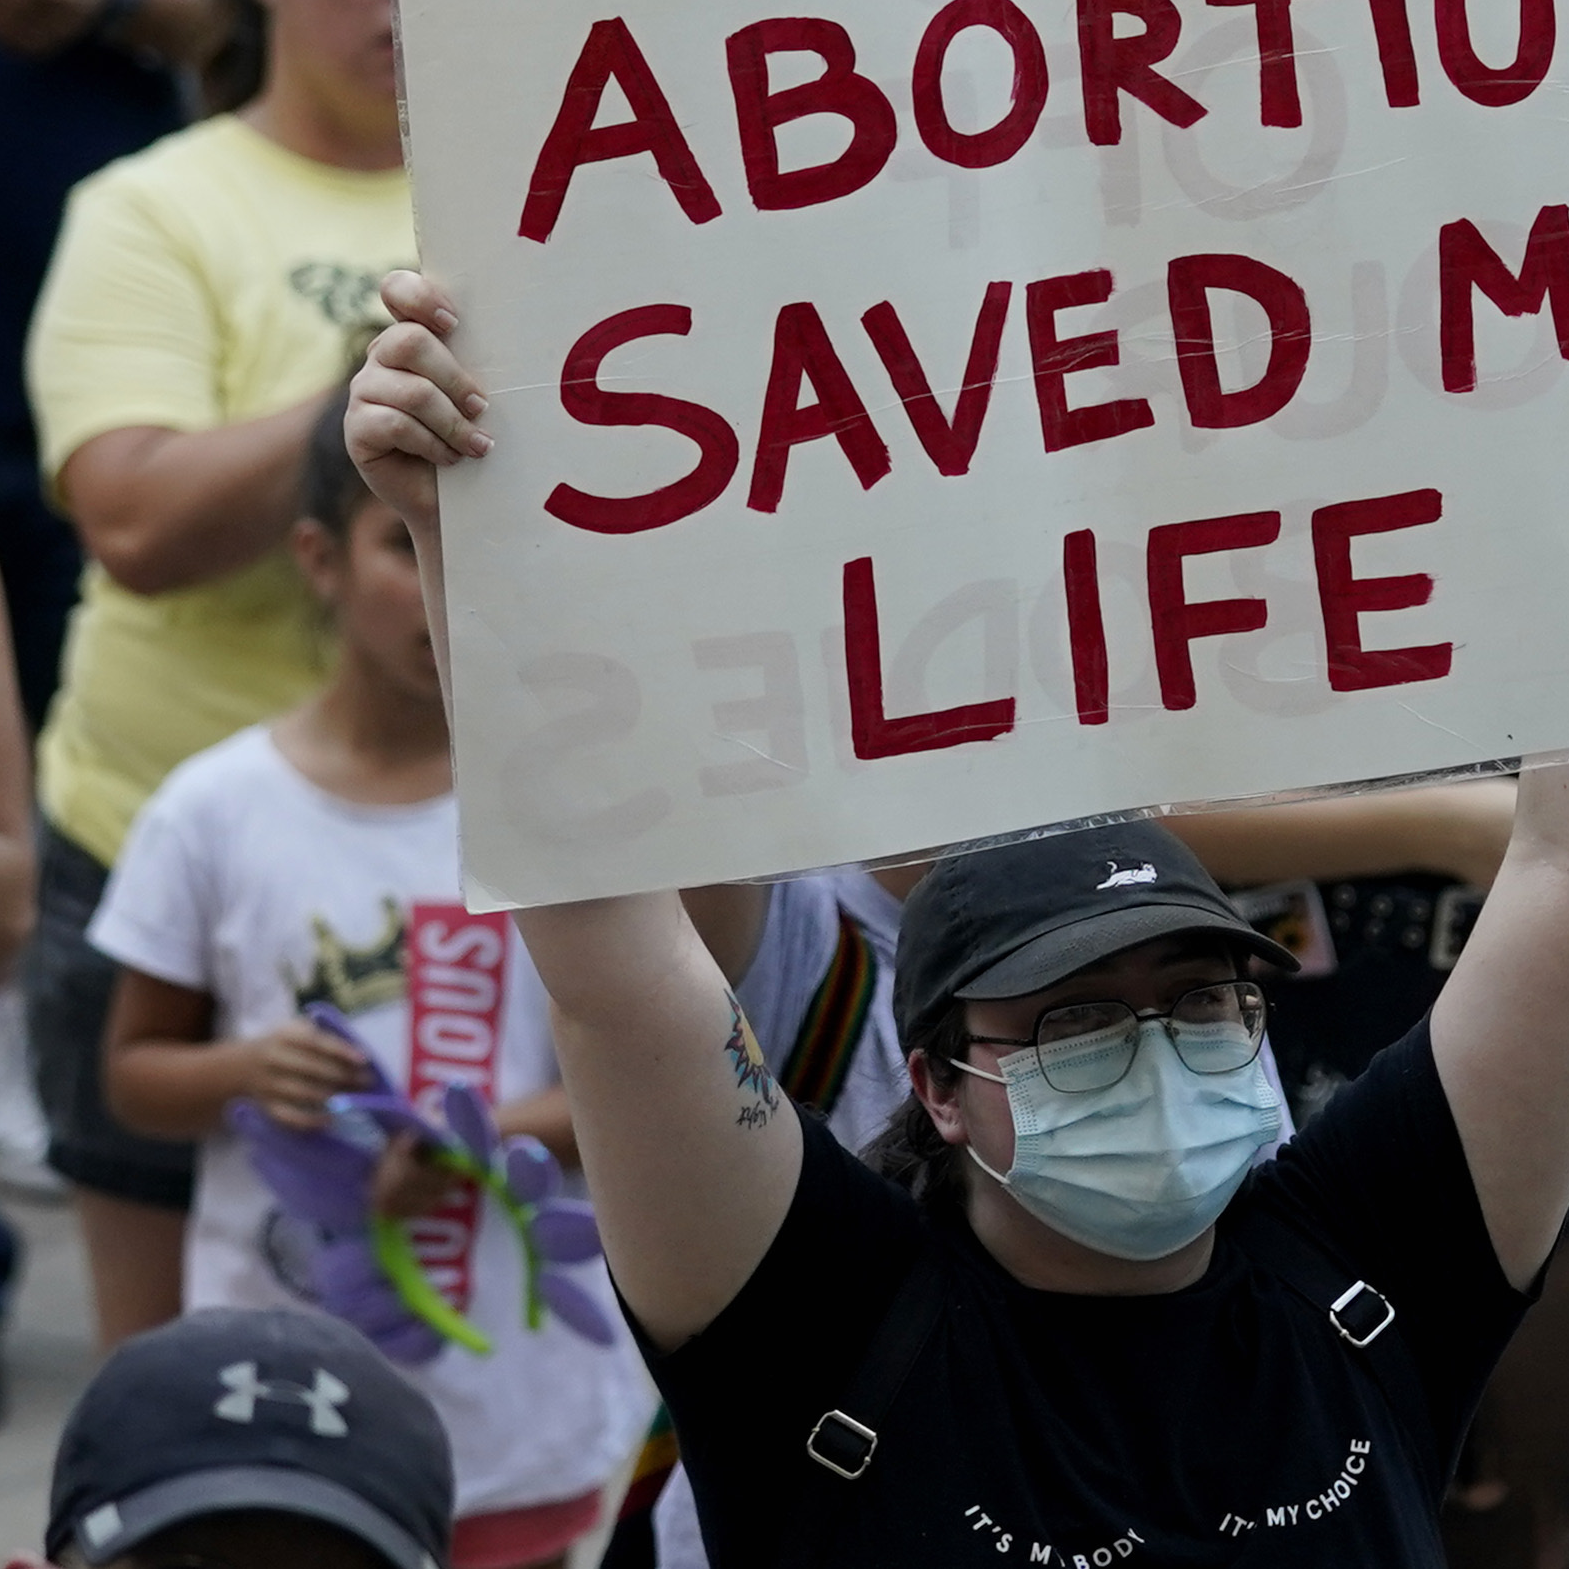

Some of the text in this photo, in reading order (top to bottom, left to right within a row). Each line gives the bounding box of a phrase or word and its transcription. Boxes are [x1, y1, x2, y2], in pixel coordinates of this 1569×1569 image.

[543, 252, 1313, 537] SAVED
[841, 487, 1453, 761] LIFE
[964, 1504, 1013, 1553] IT'S
[1265, 1504, 1300, 1528] MY
[1305, 1438, 1372, 1521] CHOICE
